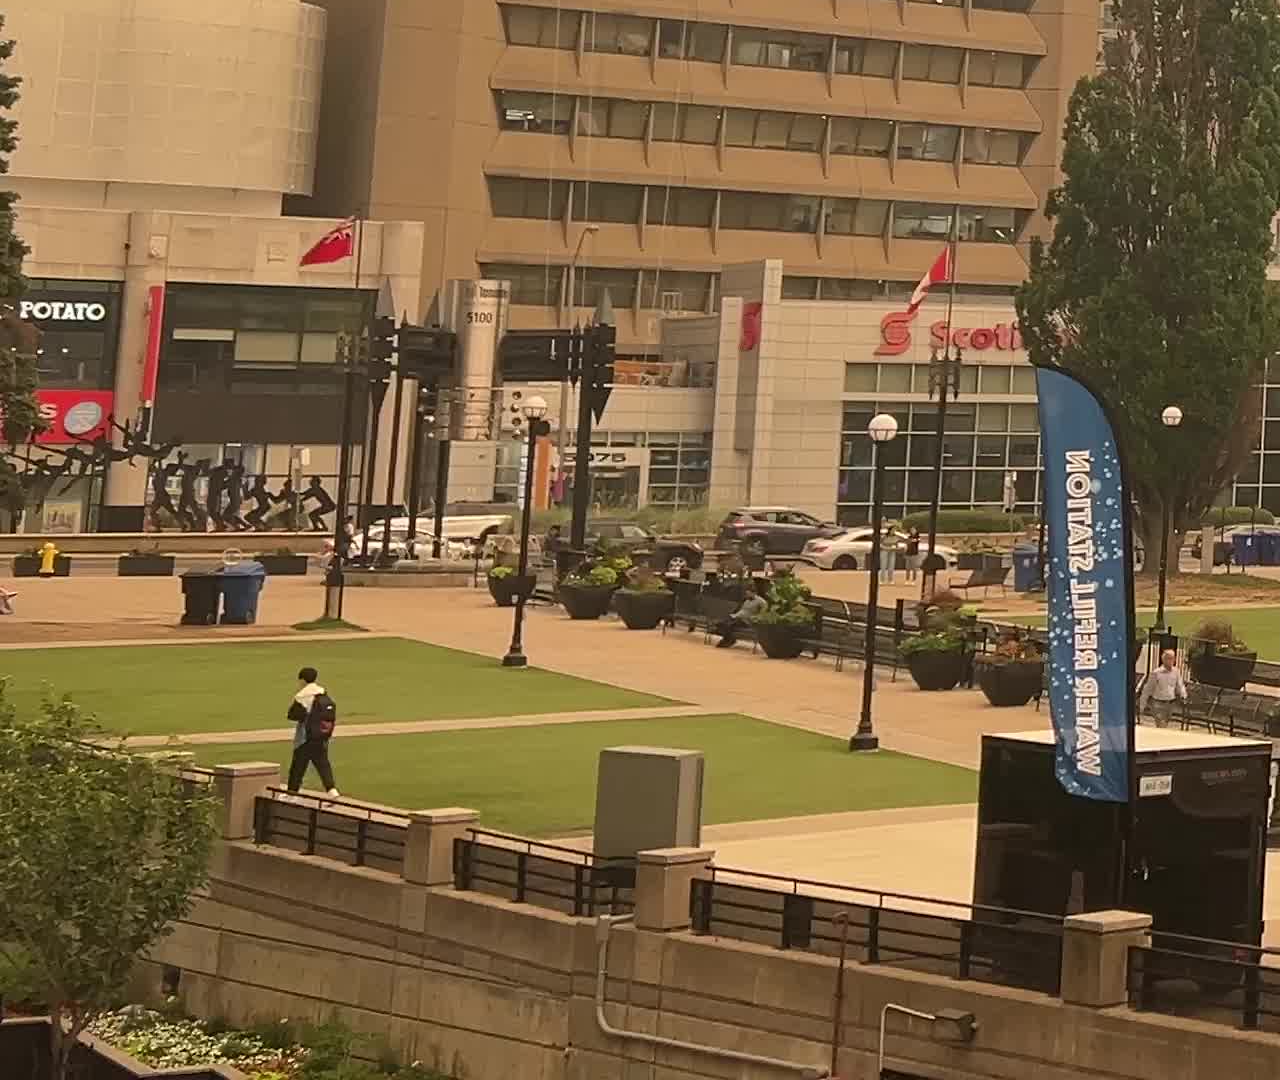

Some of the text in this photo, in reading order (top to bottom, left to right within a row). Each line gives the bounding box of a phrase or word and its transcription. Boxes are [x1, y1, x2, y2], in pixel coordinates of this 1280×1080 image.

[20, 301, 105, 320] POTATO
[466, 311, 493, 324] 5100
[930, 320, 1023, 351] Scoti
